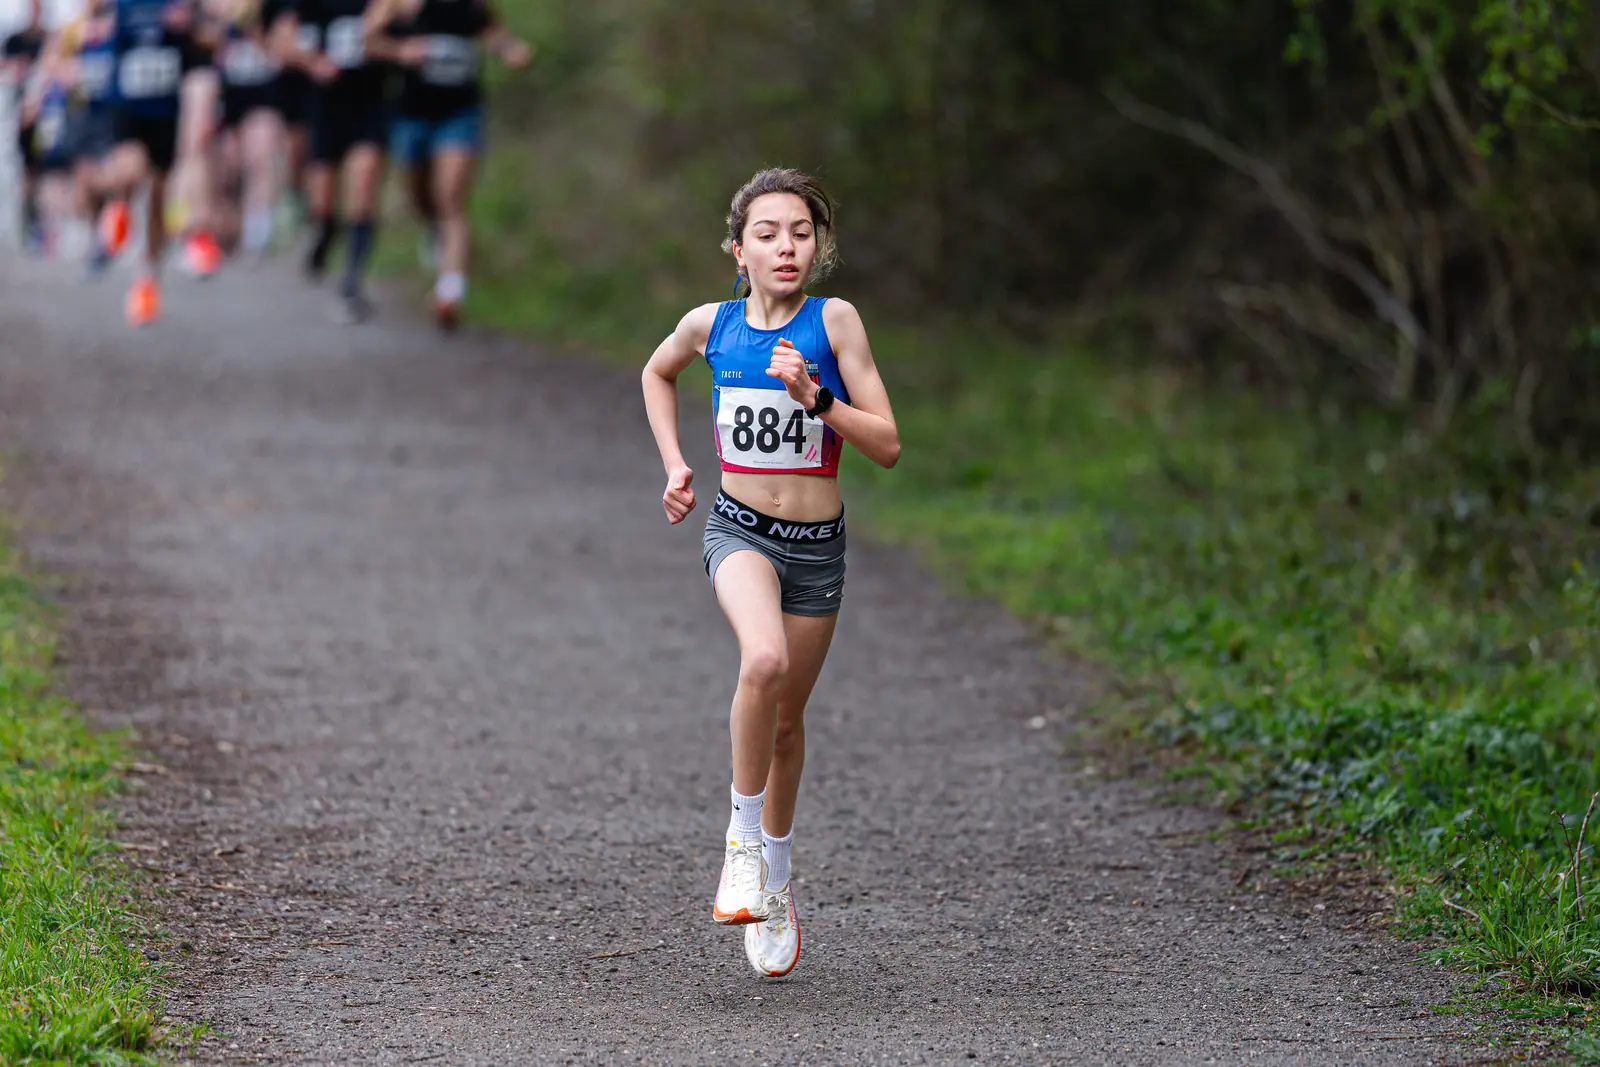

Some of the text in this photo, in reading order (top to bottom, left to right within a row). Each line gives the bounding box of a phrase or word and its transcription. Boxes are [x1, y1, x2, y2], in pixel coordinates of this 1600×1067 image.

[721, 370, 742, 378] TACTIC
[733, 405, 806, 454] 884
[768, 523, 835, 539] NIKE
